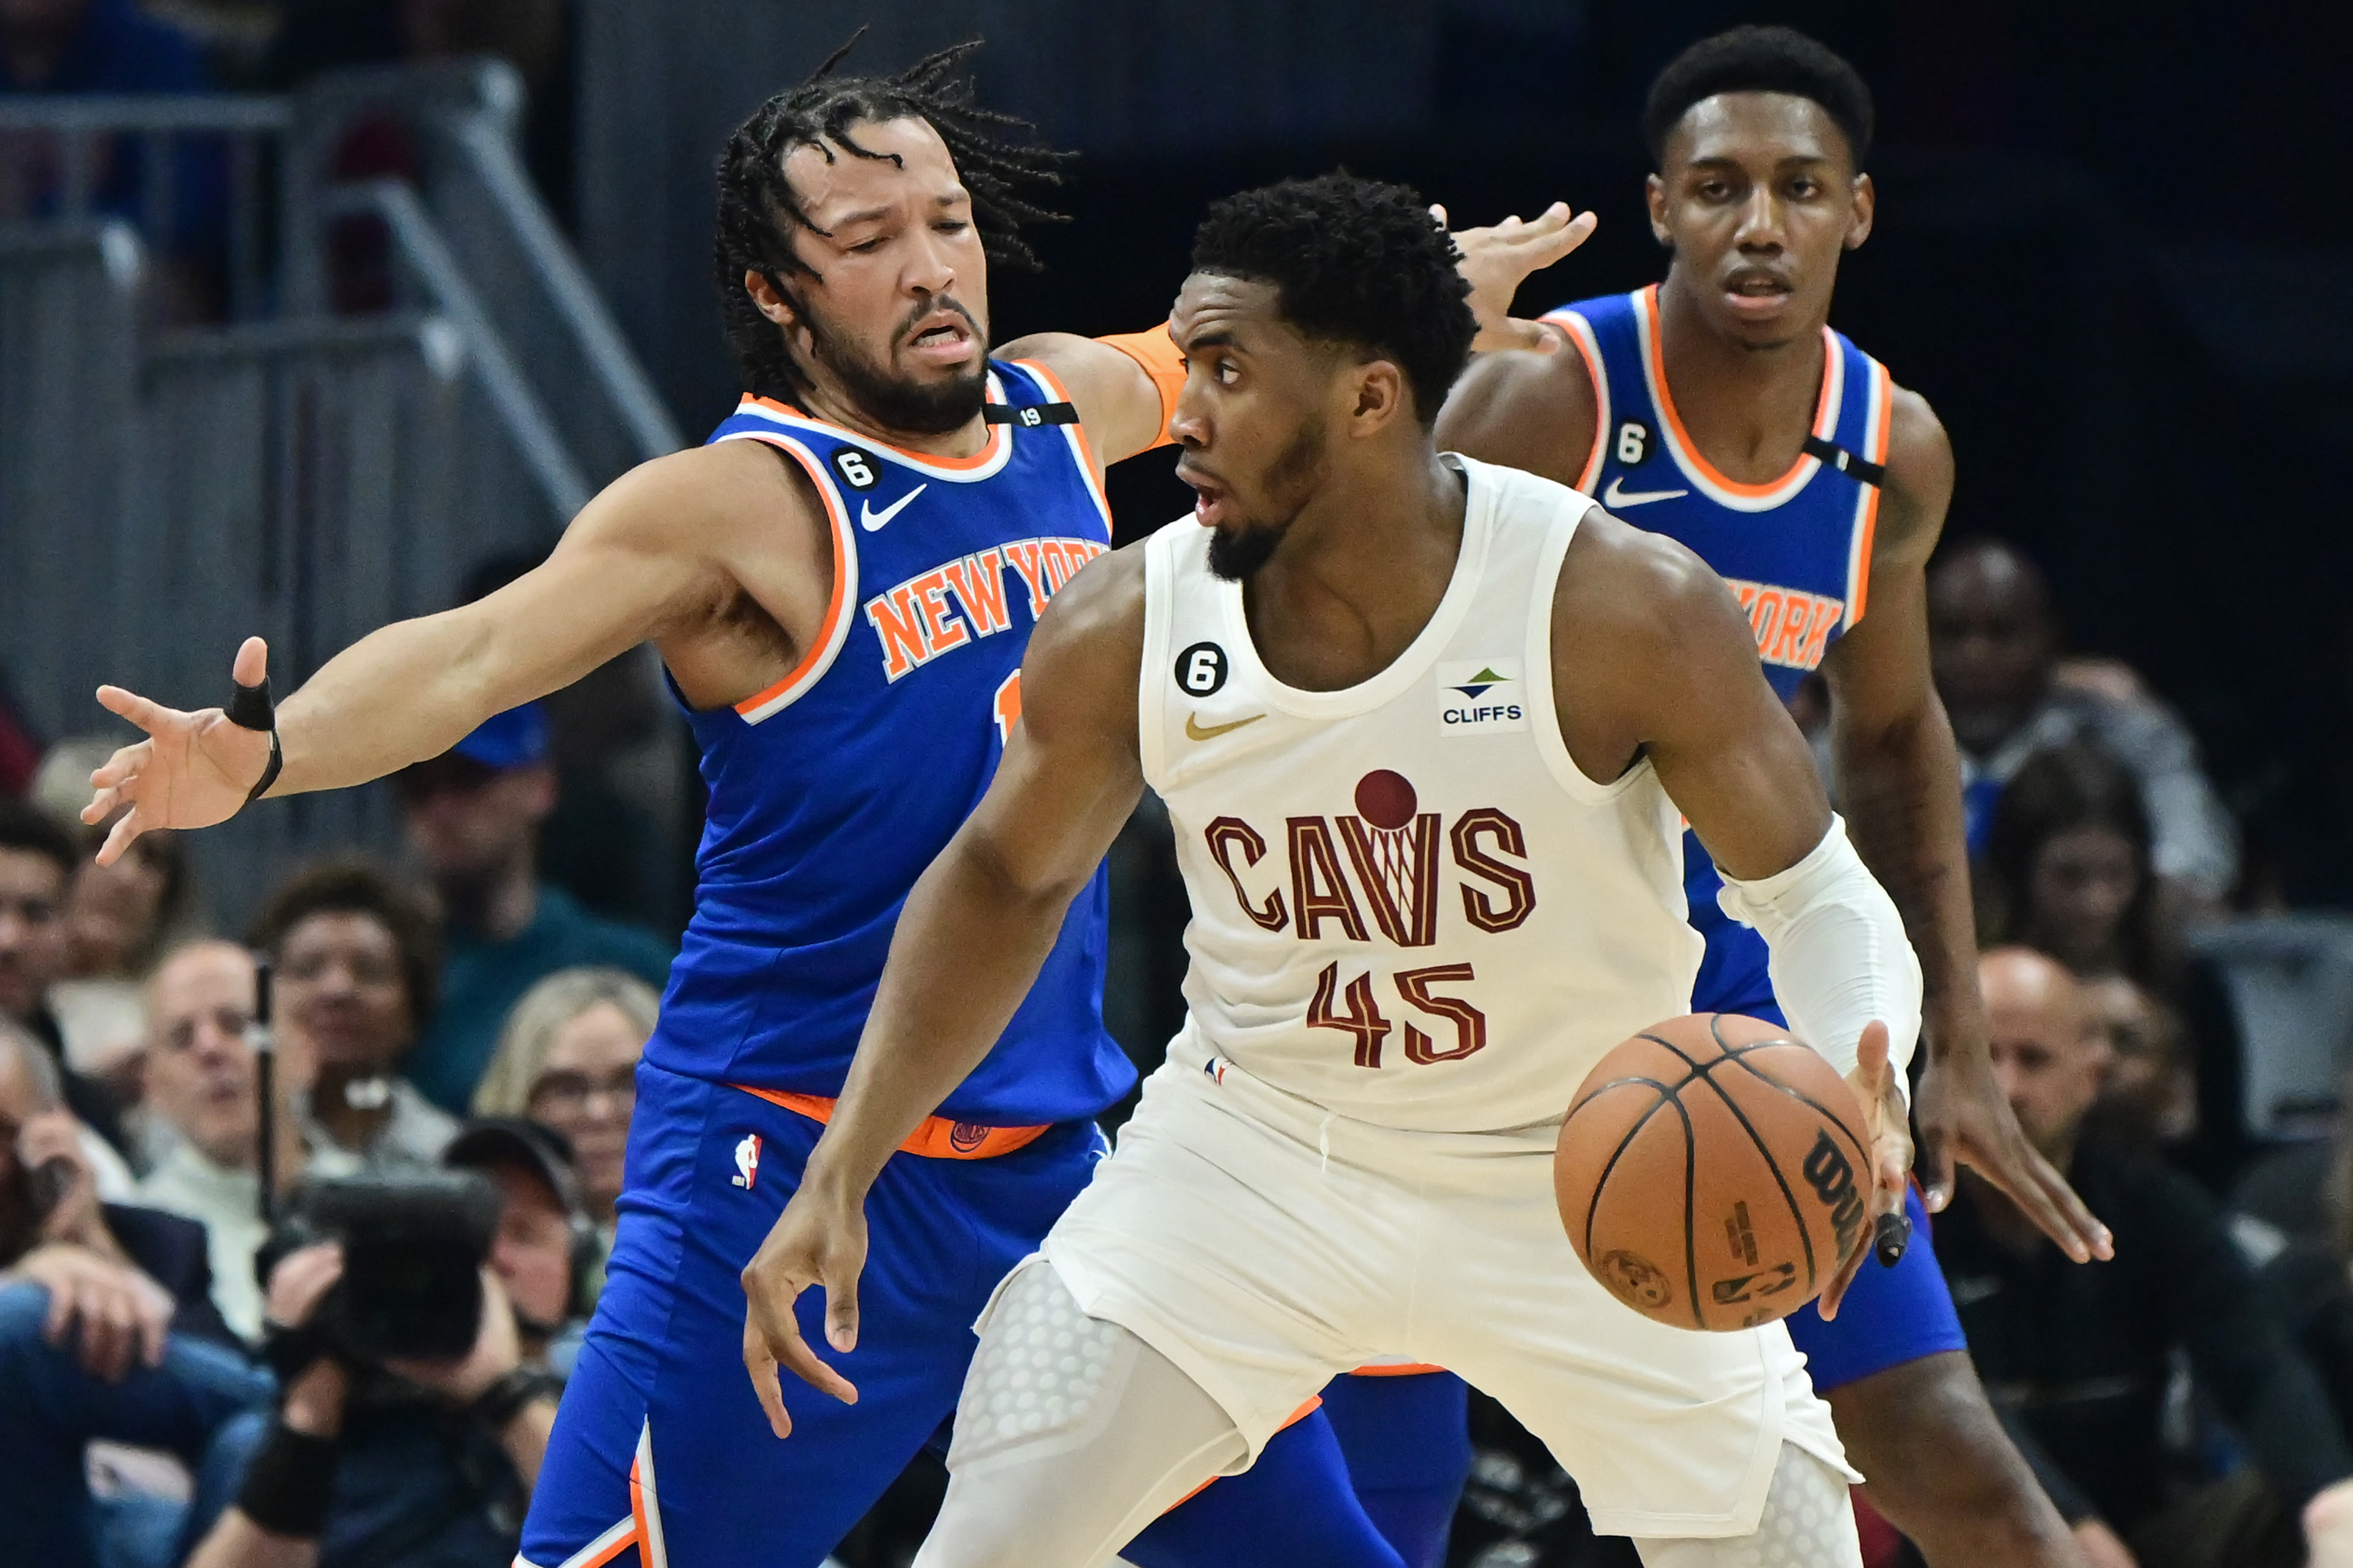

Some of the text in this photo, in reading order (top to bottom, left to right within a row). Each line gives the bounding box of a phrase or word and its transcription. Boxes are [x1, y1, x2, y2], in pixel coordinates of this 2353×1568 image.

[1020, 407, 1042, 427] 19
[1617, 422, 1647, 464] 6
[837, 451, 874, 487] 6
[863, 549, 1013, 685] NEW
[1721, 577, 1845, 672] ORK
[1186, 650, 1219, 691] 6
[1442, 704, 1522, 724] CLIFFS
[1204, 807, 1537, 948] CAVS
[1306, 960, 1487, 1070] 45
